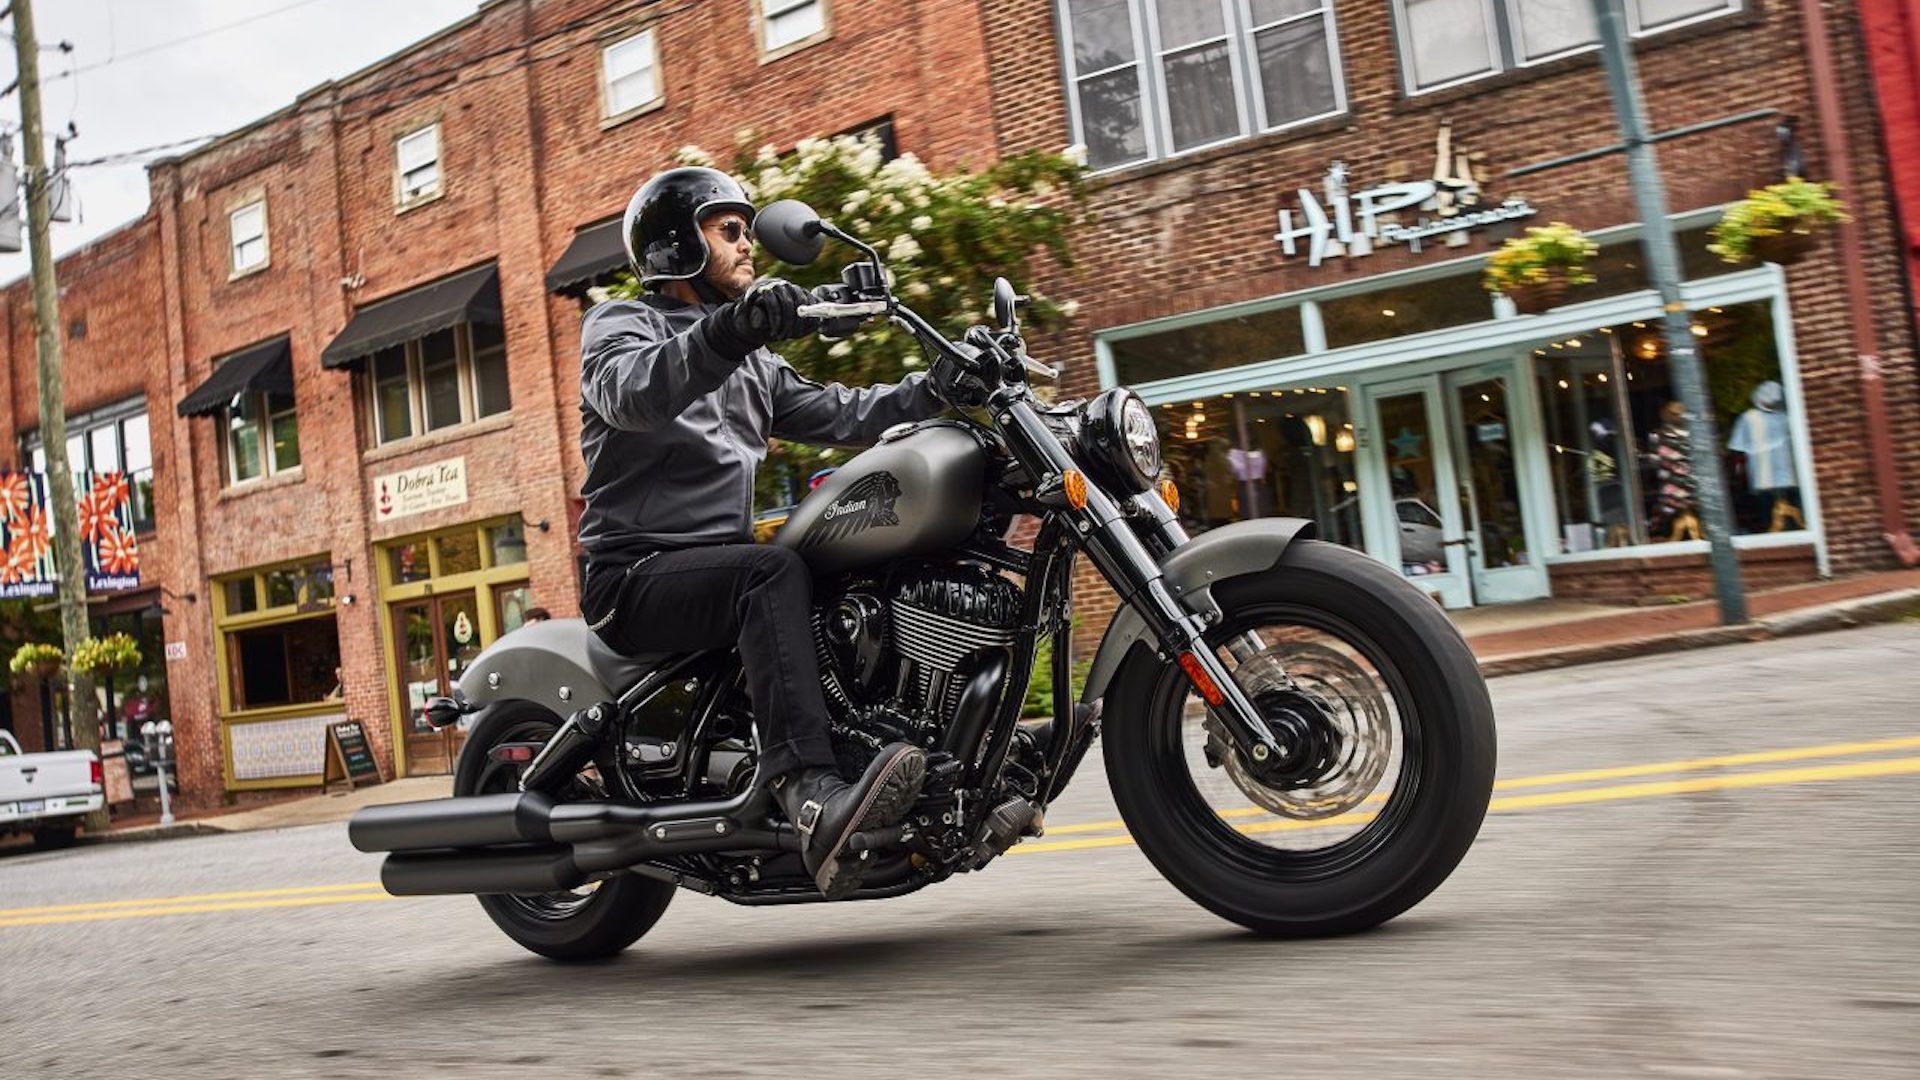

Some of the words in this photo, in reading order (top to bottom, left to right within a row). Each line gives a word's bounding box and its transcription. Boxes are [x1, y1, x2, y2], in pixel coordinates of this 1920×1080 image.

[436, 463, 458, 483] Tea
[824, 499, 867, 520] Indian
[89, 576, 138, 590] Lexington
